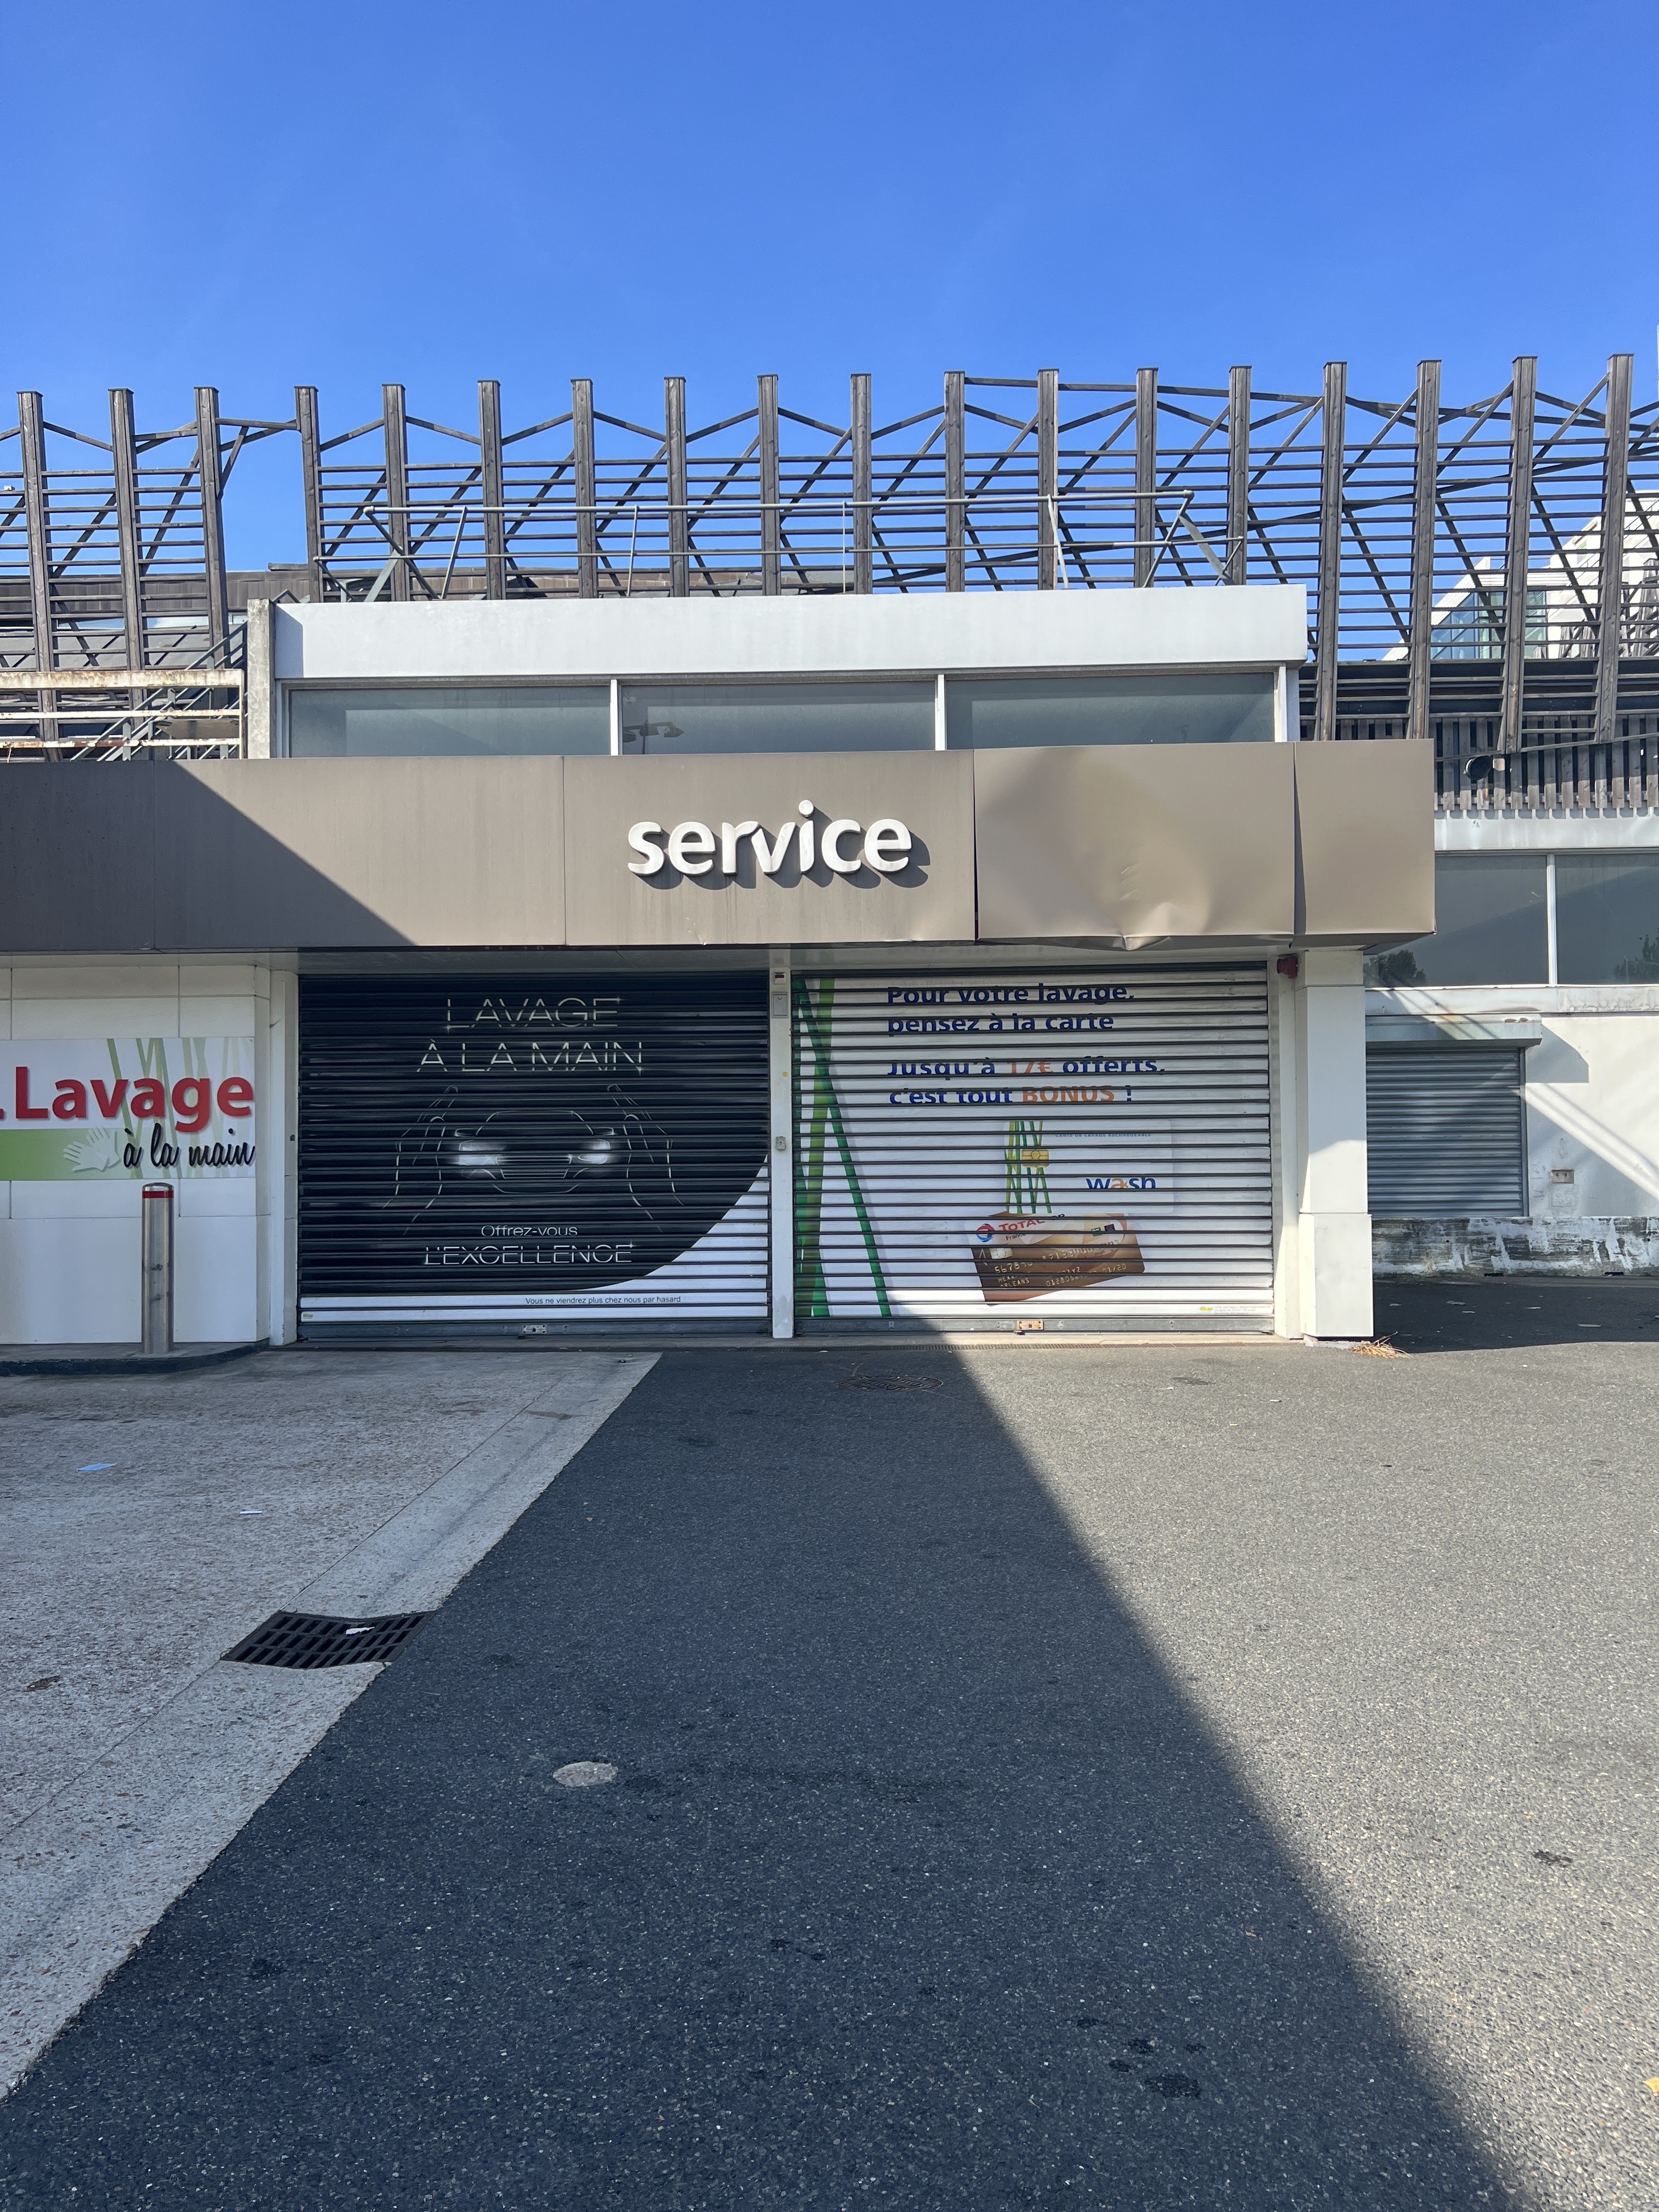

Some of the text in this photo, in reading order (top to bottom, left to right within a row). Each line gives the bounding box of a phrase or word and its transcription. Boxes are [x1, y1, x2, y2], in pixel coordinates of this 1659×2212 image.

[628, 799, 912, 876] service
[887, 986, 949, 1004] Pour
[957, 986, 1029, 1003] votre
[445, 997, 619, 1029] LAVAGE
[888, 1013, 1114, 1036] pensez à la carte
[461, 1042, 518, 1073] LA
[532, 1041, 643, 1074] MAIN
[889, 1087, 948, 1104] c'est
[956, 1087, 1013, 1104] tout
[1021, 1085, 1115, 1103] BONUS
[123, 1122, 256, 1167] à la main
[1085, 1177, 1156, 1189] wash
[481, 1224, 578, 1237] Offrez-vous
[424, 1244, 633, 1266] L'EXCELLENCE
[588, 1296, 603, 1305] plus
